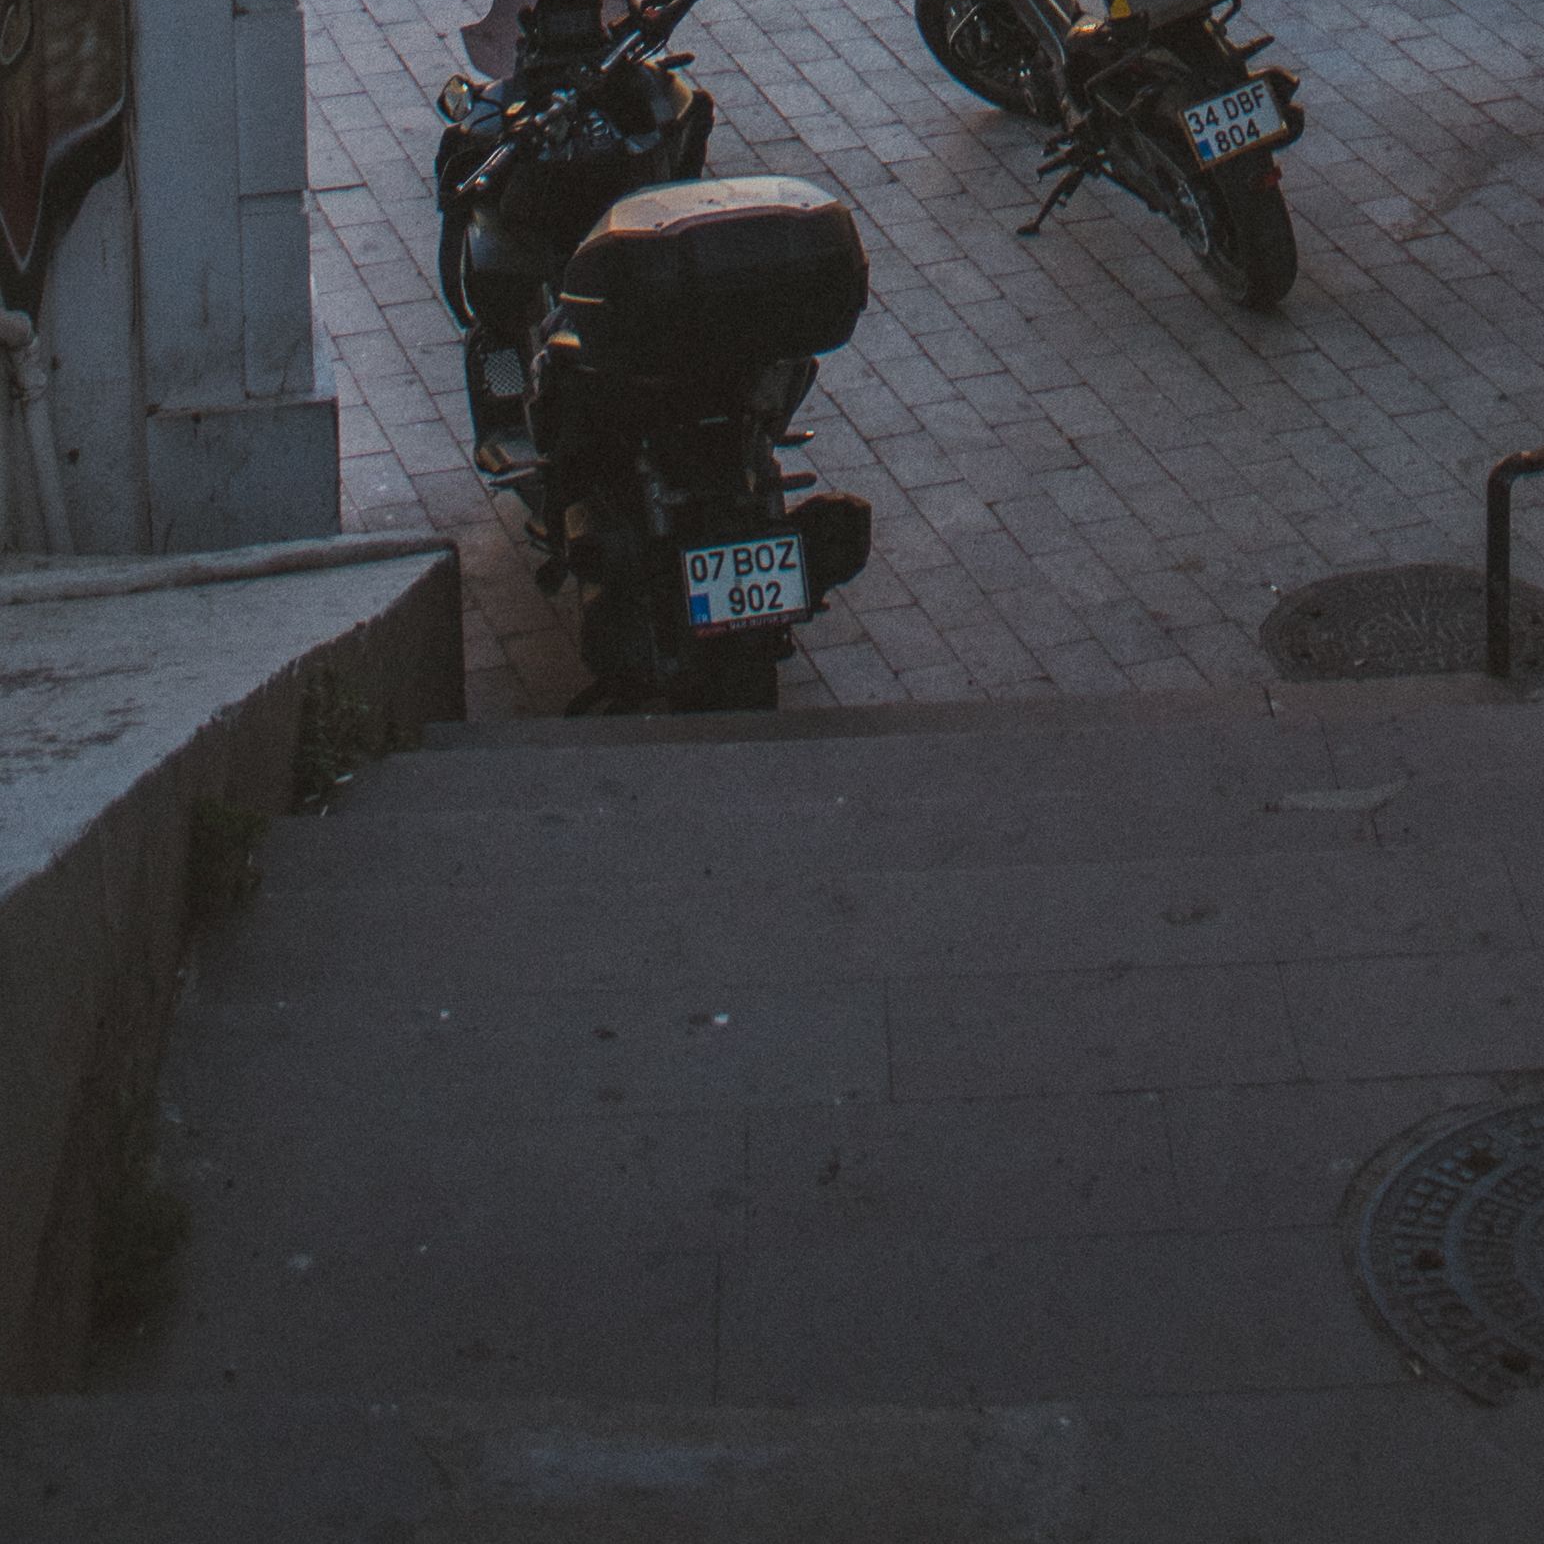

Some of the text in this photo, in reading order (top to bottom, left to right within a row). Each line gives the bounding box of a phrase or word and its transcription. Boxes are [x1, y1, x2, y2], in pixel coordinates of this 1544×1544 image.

[1187, 83, 1264, 135] 34 DBF
[1214, 117, 1261, 154] 804
[690, 539, 797, 583] 07 BOZ
[728, 580, 784, 616] 902
